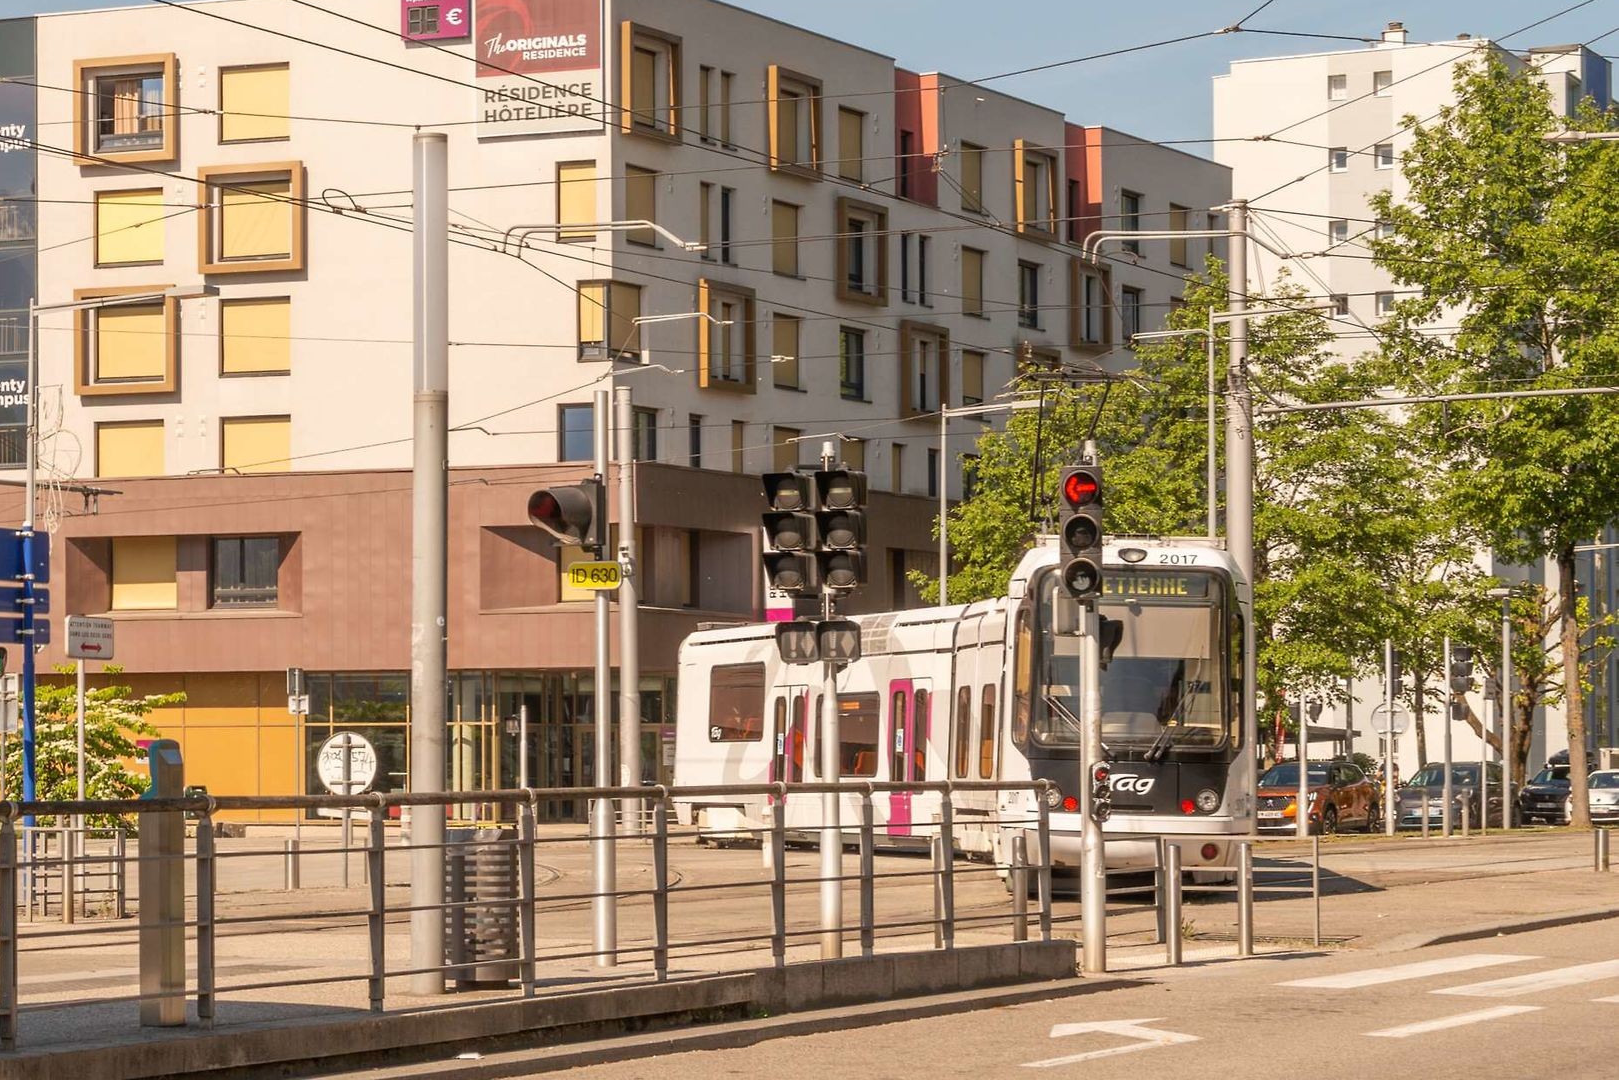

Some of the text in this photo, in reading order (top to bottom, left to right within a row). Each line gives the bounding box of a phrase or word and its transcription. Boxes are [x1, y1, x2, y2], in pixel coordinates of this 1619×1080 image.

[445, 8, 462, 25] €
[484, 32, 587, 59] The ORIGINALS
[523, 47, 586, 61] RESIDENCE
[484, 82, 592, 103] RÉSIDENCE
[484, 100, 592, 123] HÔTELIÈRE
[1159, 554, 1198, 565] 2017
[571, 567, 618, 584] ID 630
[1102, 577, 1188, 595] ETIENNE
[1109, 773, 1156, 796] Tag
